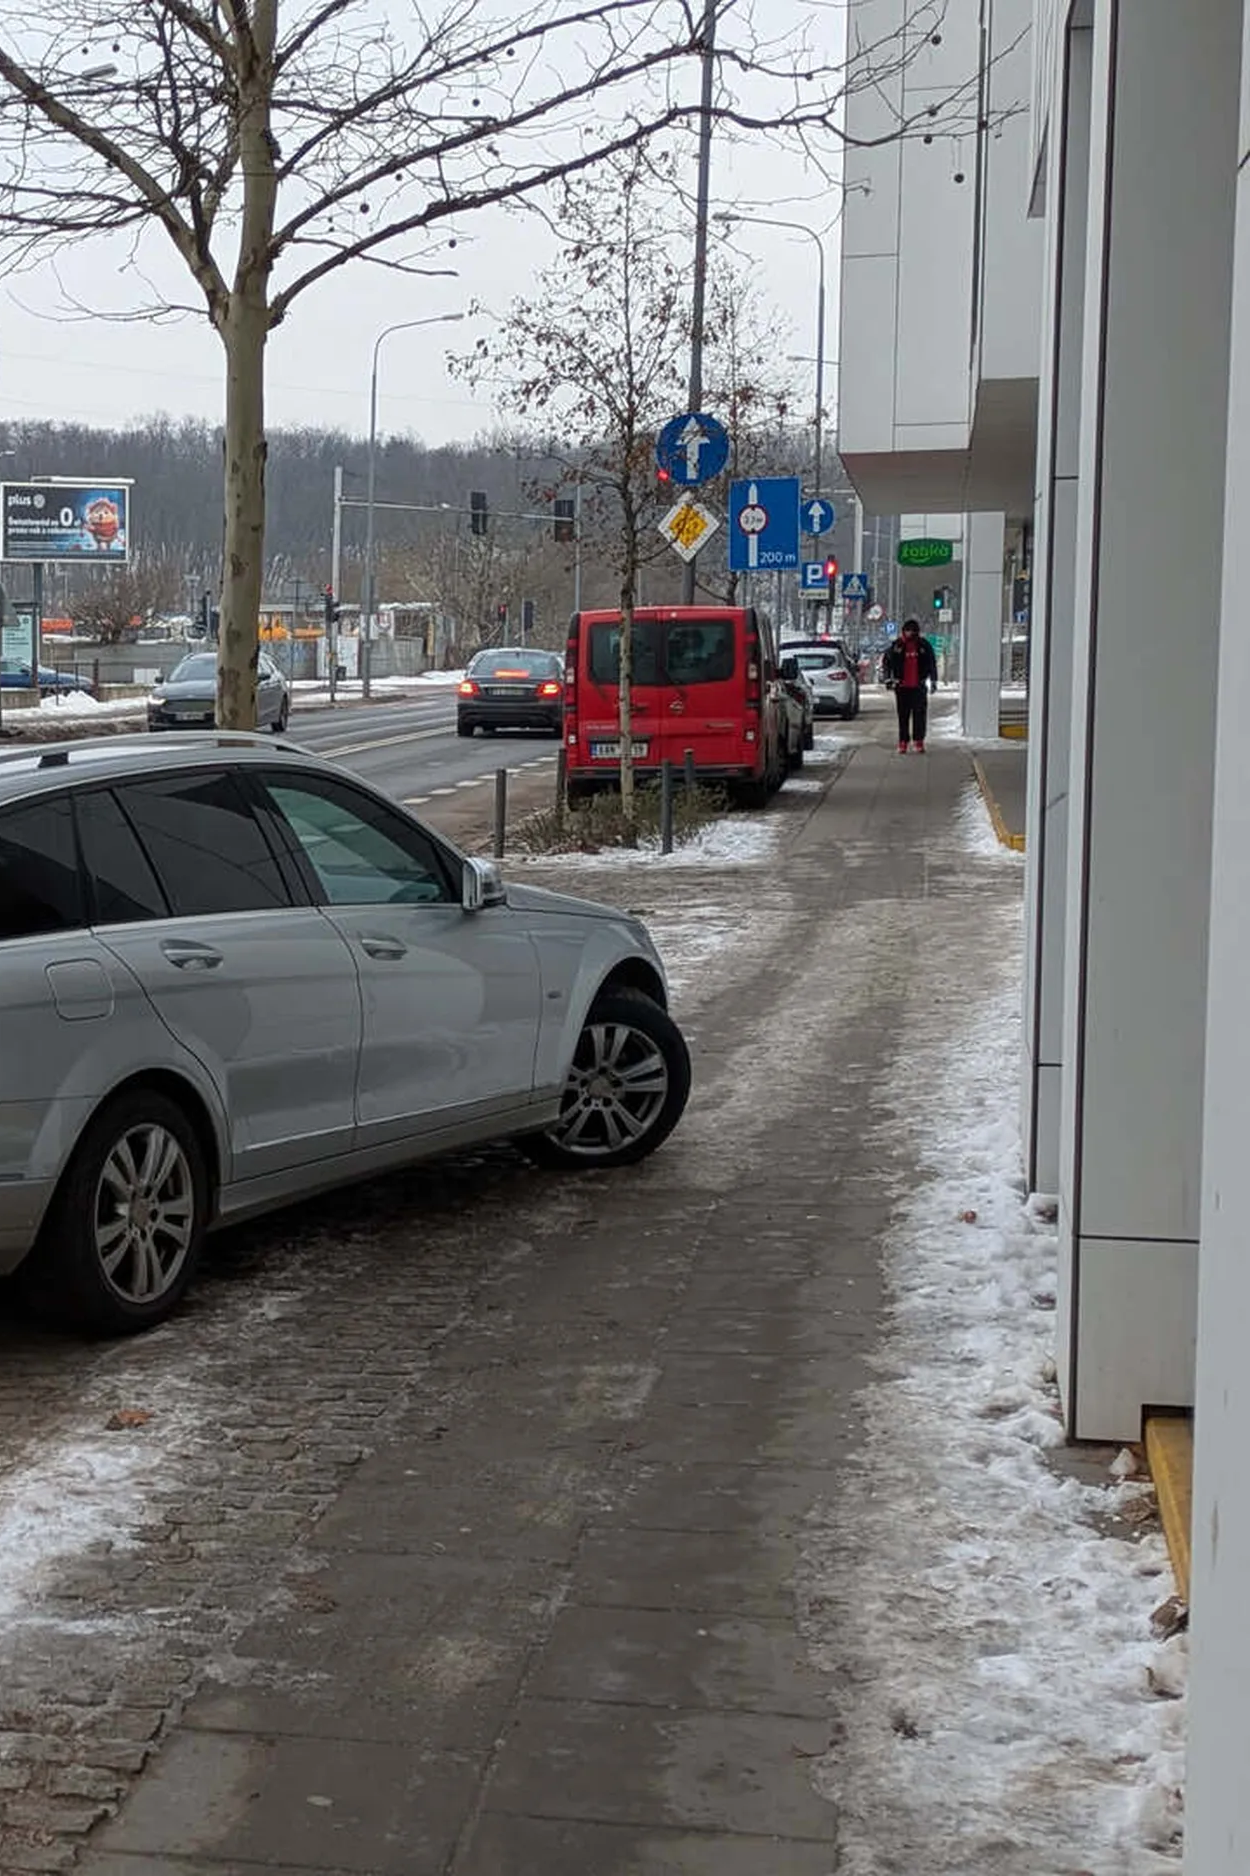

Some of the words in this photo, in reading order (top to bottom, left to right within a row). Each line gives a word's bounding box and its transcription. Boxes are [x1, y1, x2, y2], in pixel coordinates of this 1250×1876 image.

[8, 494, 31, 506] plus
[60, 507, 73, 527] 0
[760, 551, 783, 564] 200
[785, 553, 796, 563] m
[807, 564, 823, 586] P
